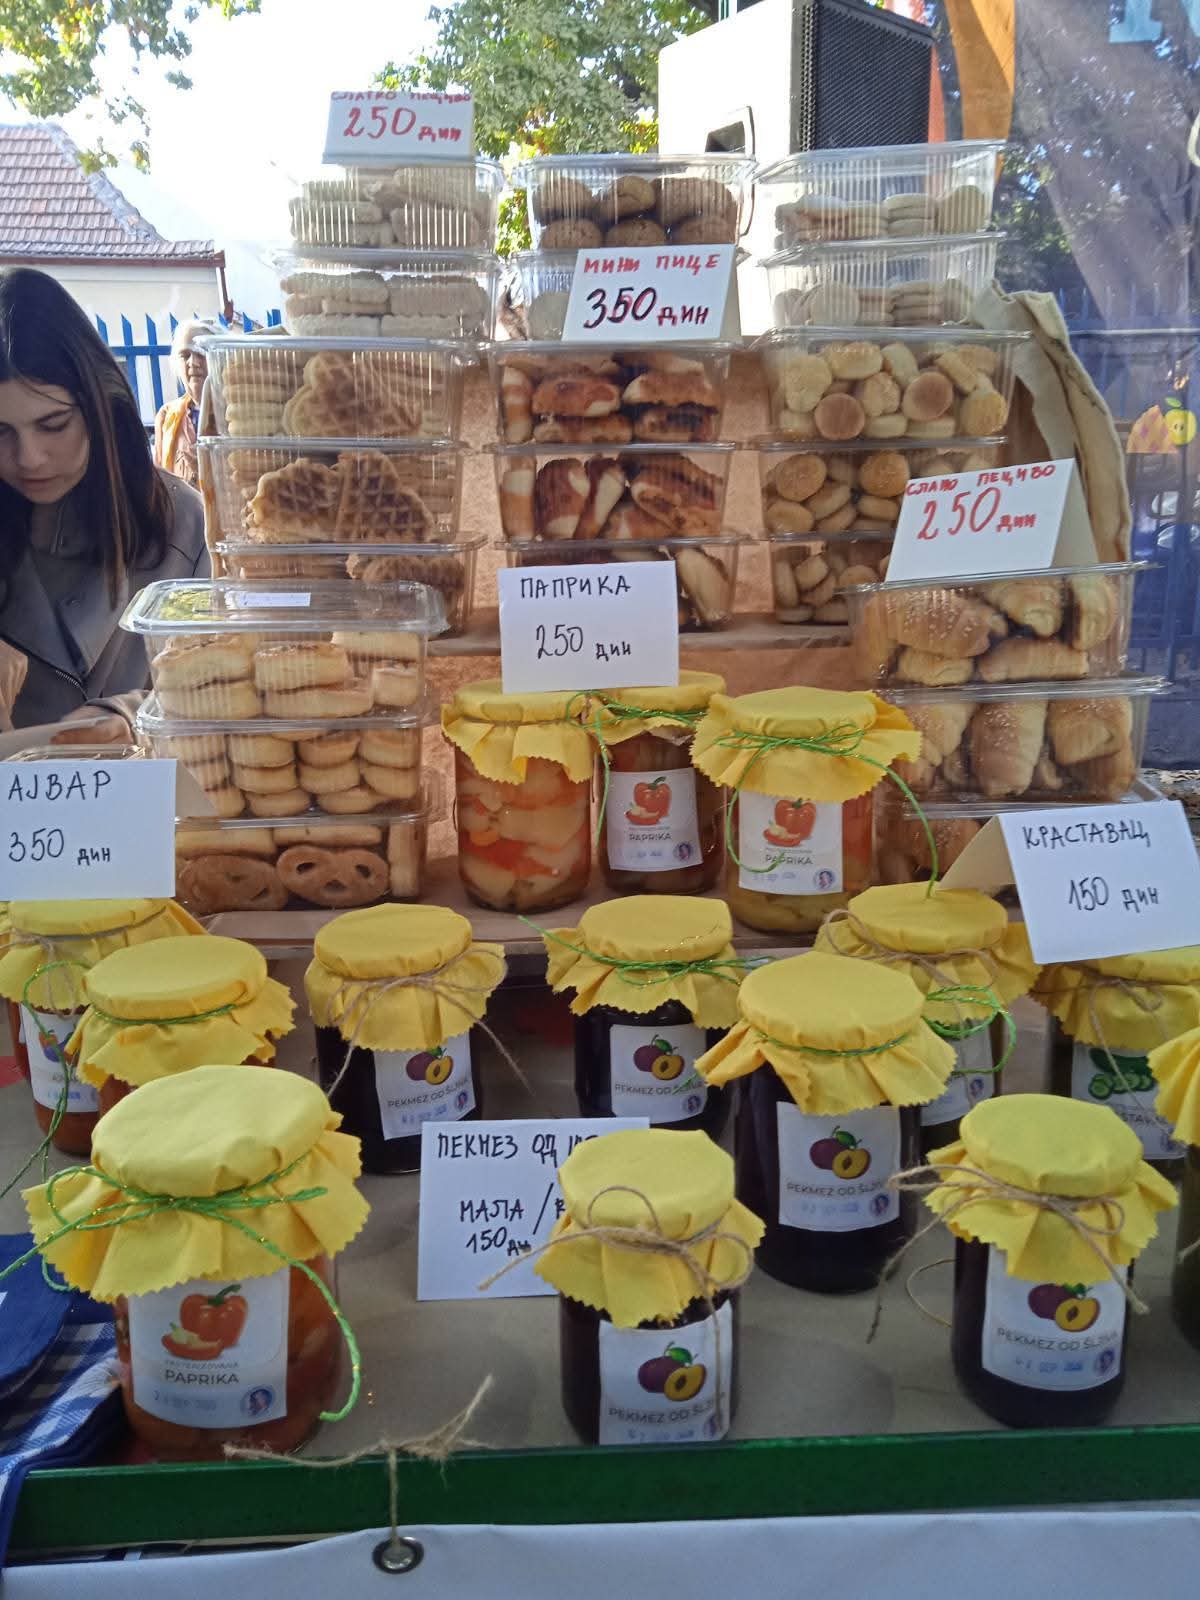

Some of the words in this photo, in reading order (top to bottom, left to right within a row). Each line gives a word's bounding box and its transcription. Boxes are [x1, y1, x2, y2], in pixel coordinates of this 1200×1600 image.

[343, 106, 417, 139] 250
[584, 256, 641, 274] МИНИ
[655, 253, 721, 276] ПИЦЕ
[583, 287, 657, 329] 350
[917, 487, 1002, 540] 250
[520, 575, 632, 599] ПАПРИКА
[536, 624, 584, 659] 250
[8, 770, 112, 802] АЈВАР
[8, 828, 65, 862] 350
[629, 832, 673, 841] PAPRIKA
[1022, 820, 1152, 849] КРАСТАВАЦ
[1068, 876, 1109, 911] 150
[387, 1094, 429, 1107] PEKMEZ
[430, 1090, 445, 1100] OD
[615, 1083, 654, 1095] PEKMEZ
[655, 1087, 672, 1095] OD
[786, 1182, 834, 1198] PEKMEZ
[837, 1186, 856, 1197] OD
[460, 1199, 524, 1223] МАЛА
[466, 1227, 508, 1254] 150
[997, 1327, 1055, 1350] PEKMEZ
[1057, 1340, 1081, 1351] OD
[165, 1369, 240, 1385] PAPRIKA
[608, 1407, 666, 1424] PEKMEZ
[669, 1408, 690, 1421] OD
